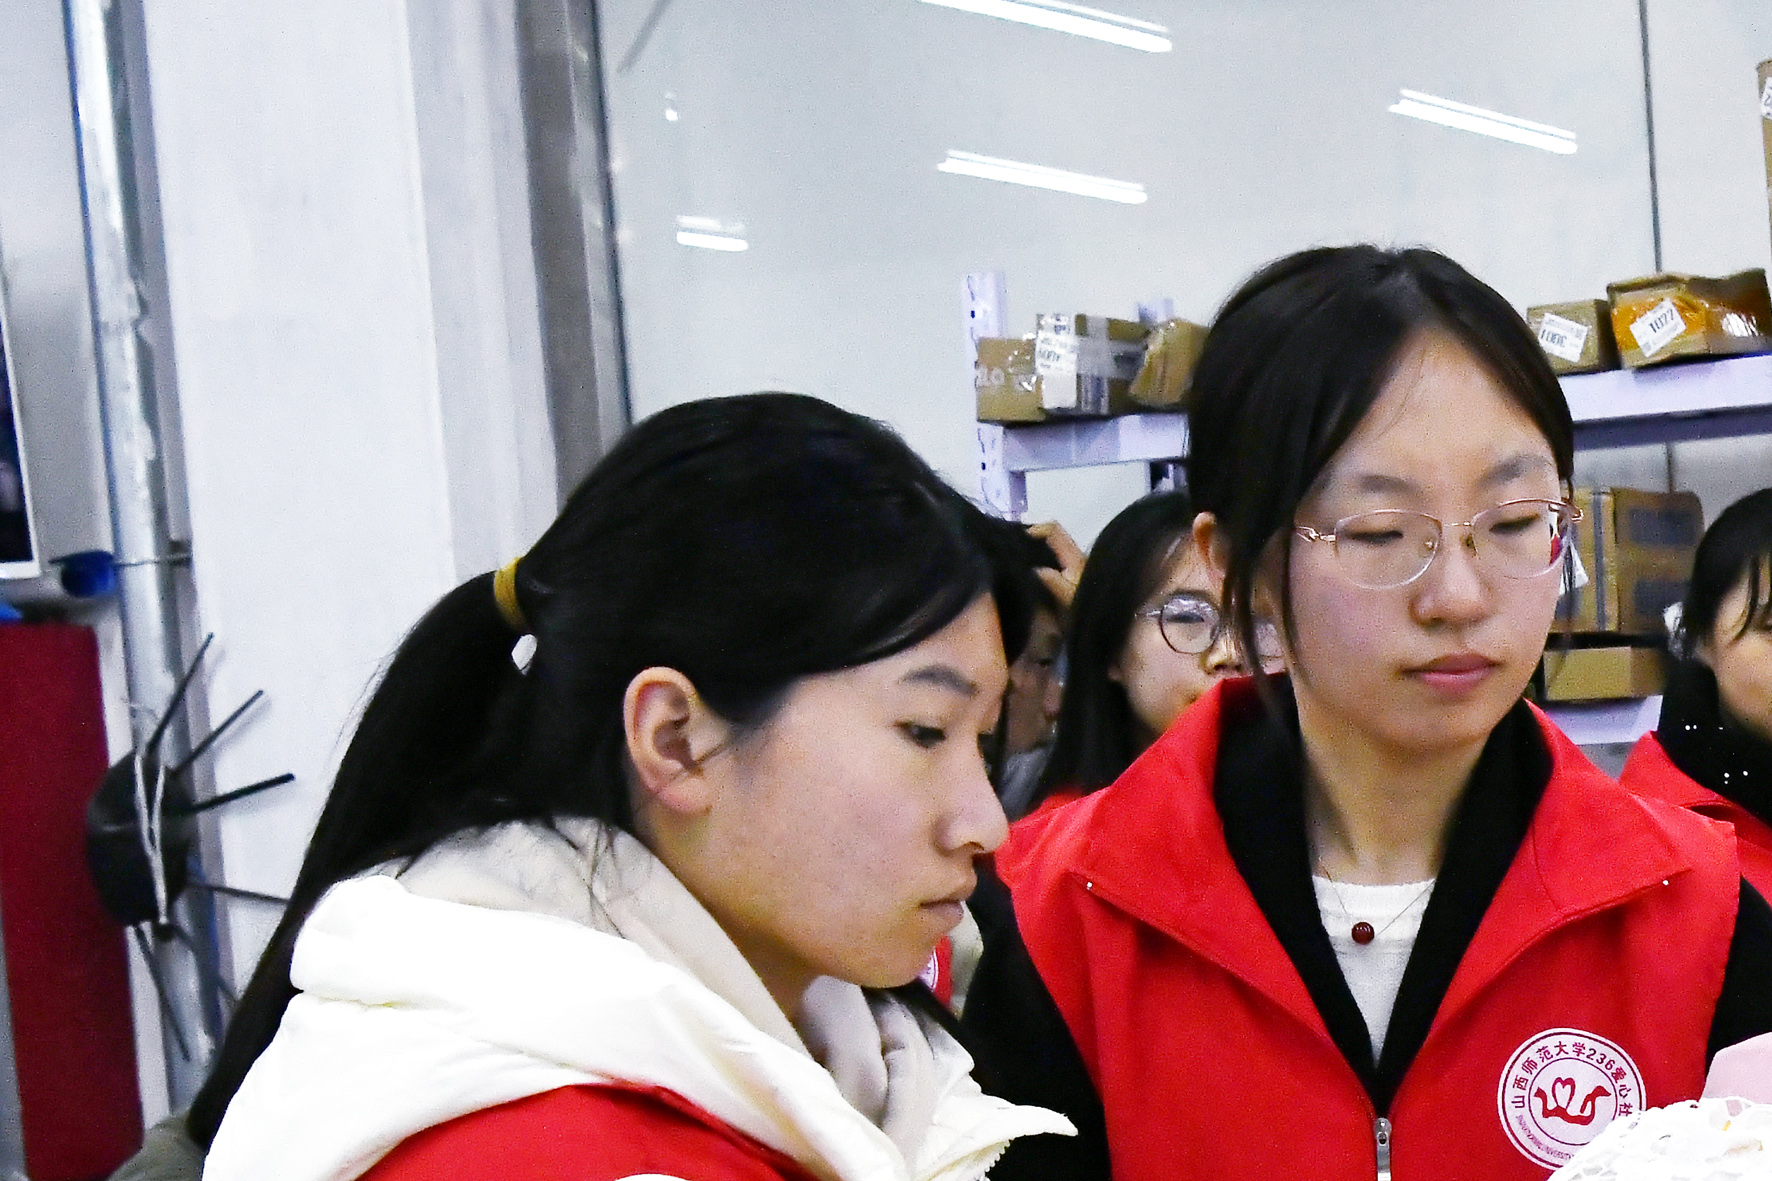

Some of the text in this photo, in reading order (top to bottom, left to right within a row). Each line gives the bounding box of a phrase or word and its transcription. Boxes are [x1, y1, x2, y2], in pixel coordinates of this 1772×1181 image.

[1511, 1041, 1633, 1117] 山西师范大学236爱心社
